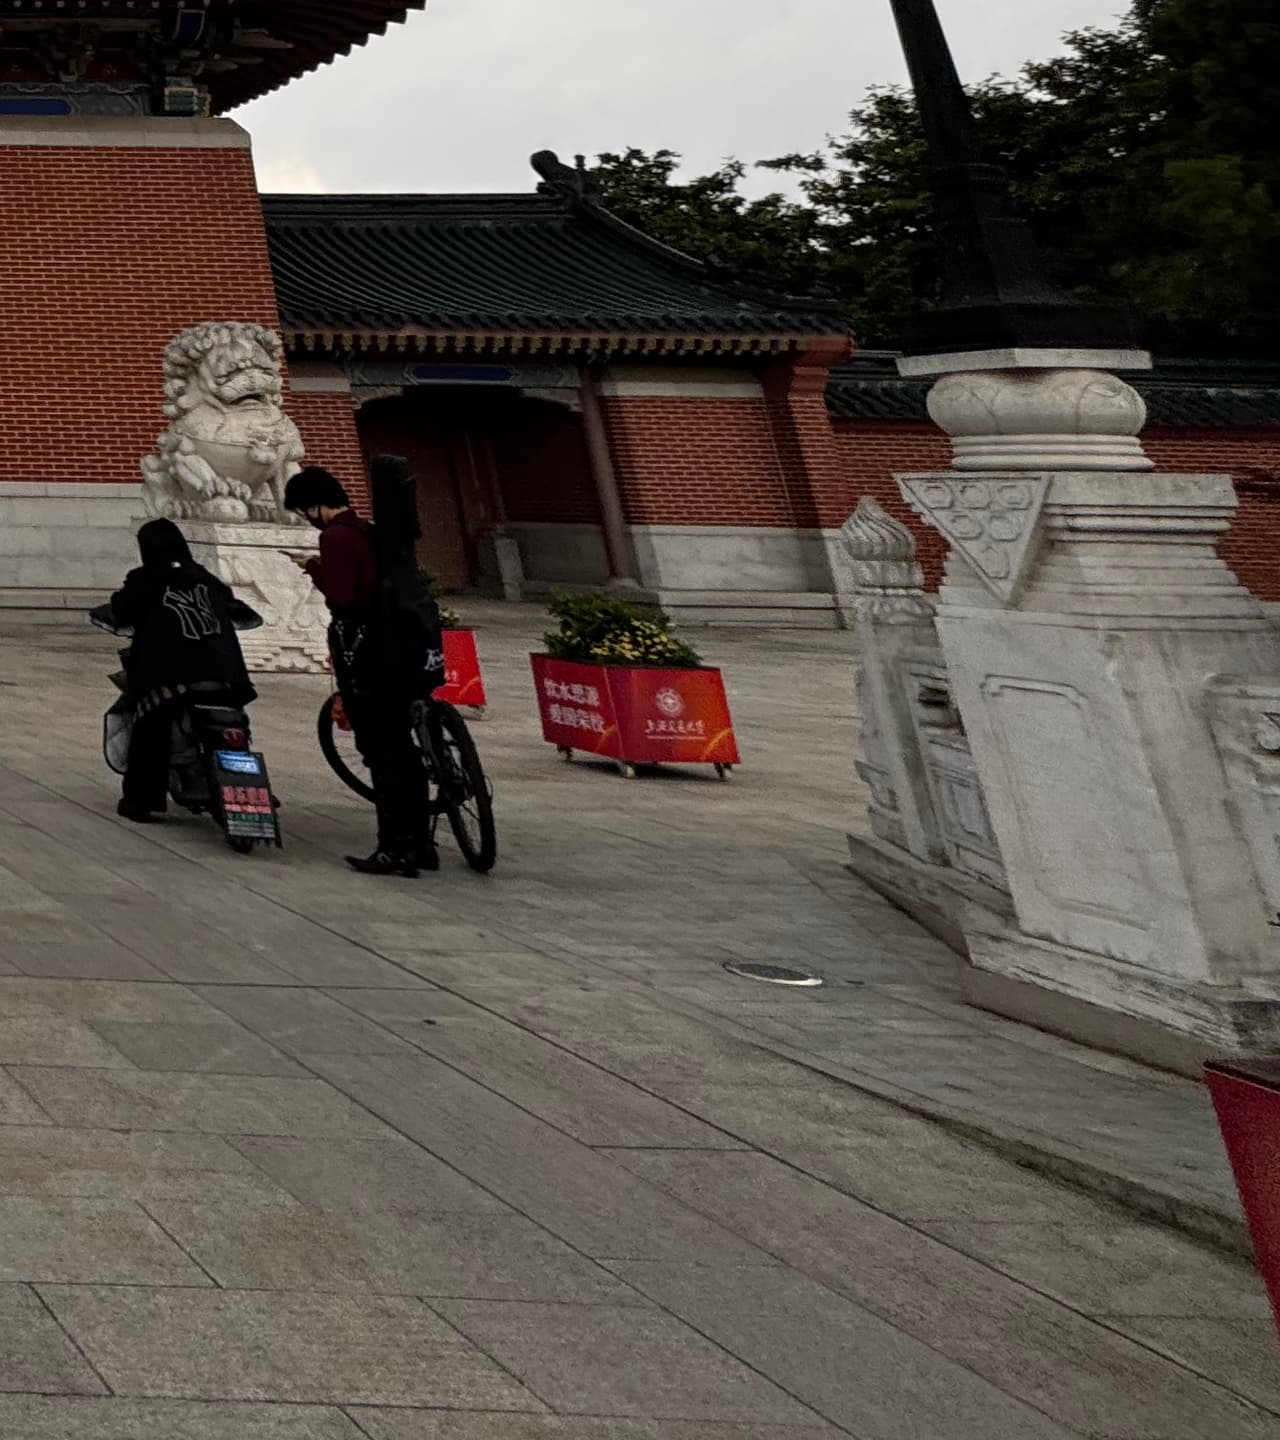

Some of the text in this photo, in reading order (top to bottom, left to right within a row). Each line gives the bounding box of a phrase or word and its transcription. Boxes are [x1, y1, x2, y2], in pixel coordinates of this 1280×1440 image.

[163, 584, 221, 640] NY
[543, 678, 600, 707] 饮水思源
[549, 704, 607, 734] 爱国荣校
